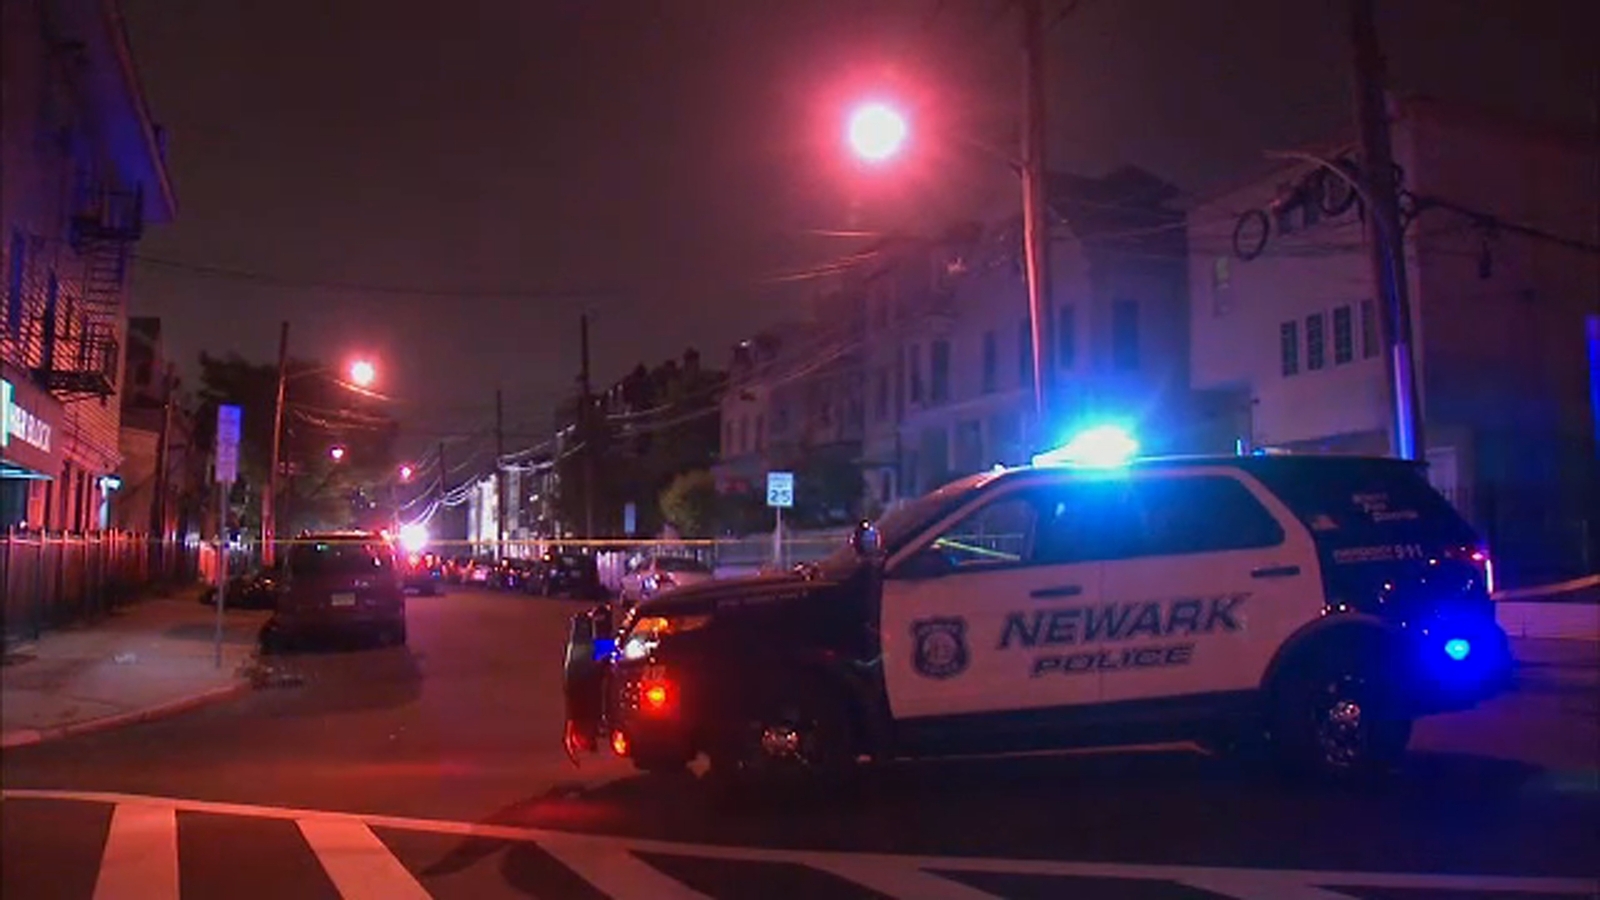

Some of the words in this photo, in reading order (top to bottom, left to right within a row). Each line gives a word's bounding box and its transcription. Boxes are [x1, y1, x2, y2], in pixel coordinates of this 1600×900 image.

[770, 489, 791, 503] 25
[996, 592, 1252, 650] NEWARK
[1030, 643, 1195, 678] POLICE
